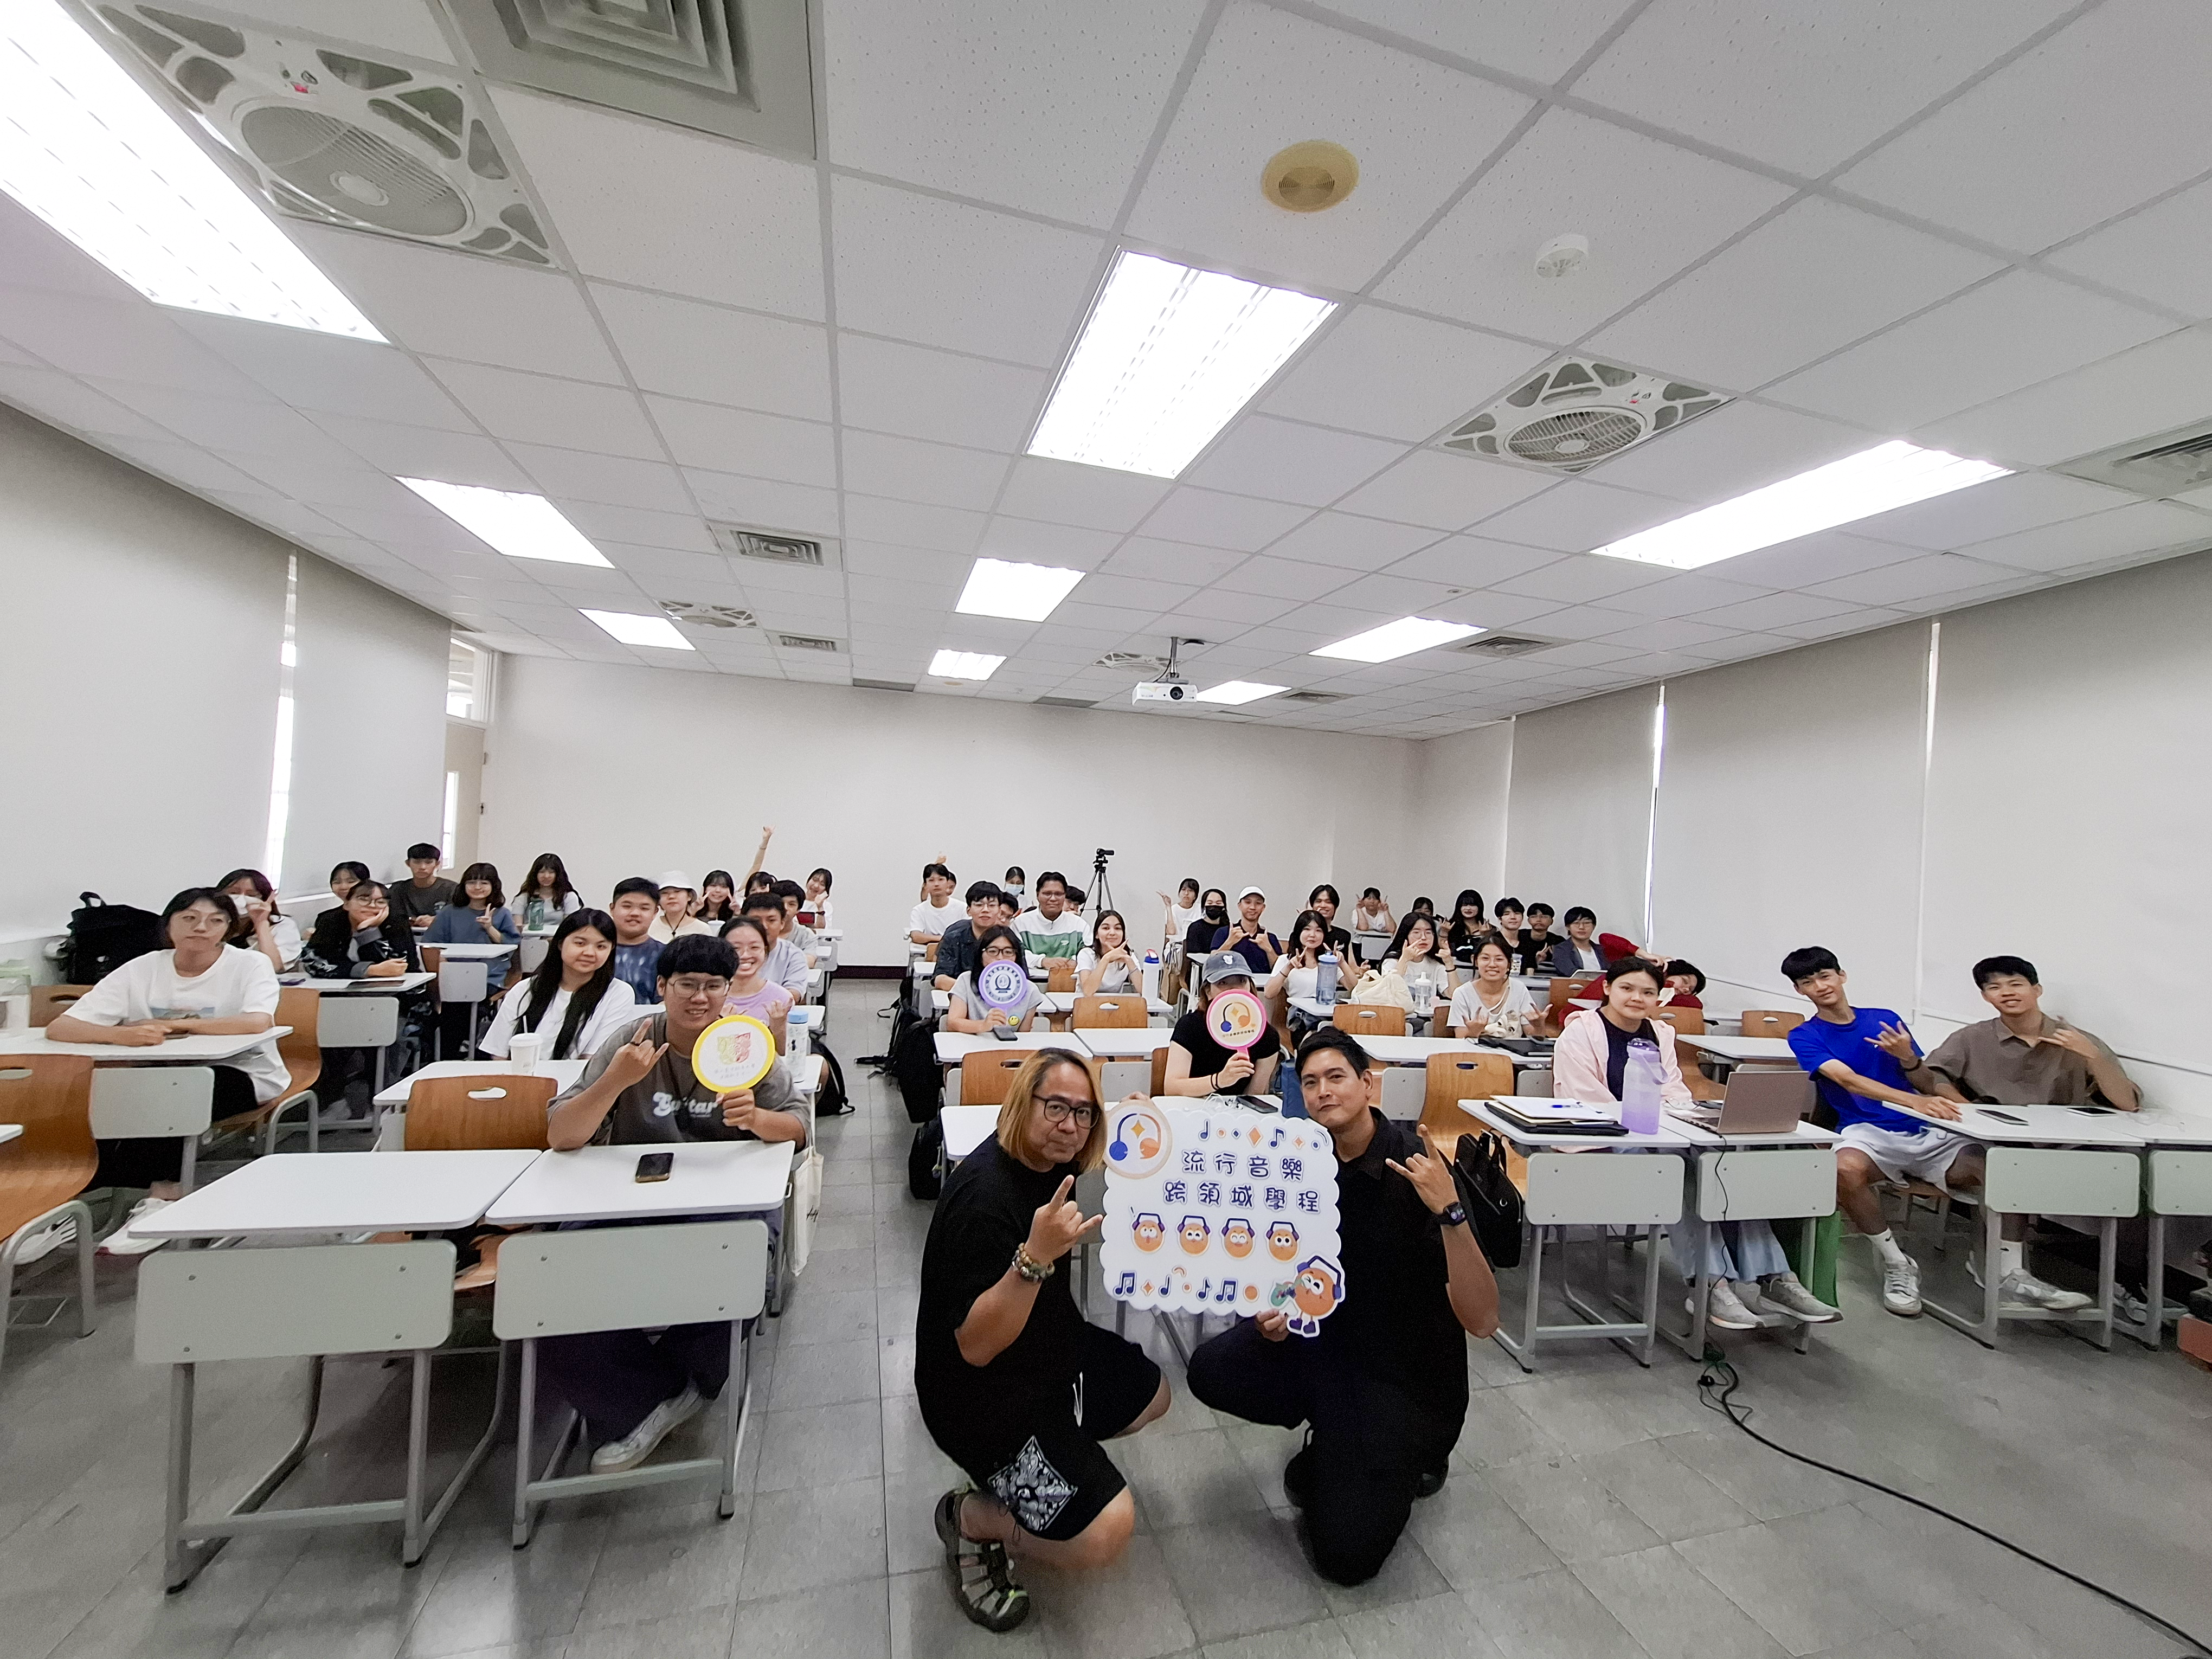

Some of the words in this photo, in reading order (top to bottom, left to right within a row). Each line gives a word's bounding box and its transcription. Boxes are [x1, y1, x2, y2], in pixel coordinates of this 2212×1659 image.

[1183, 1150, 1302, 1181] 流行音樂
[1164, 1180, 1319, 1213] 跨領域學程
